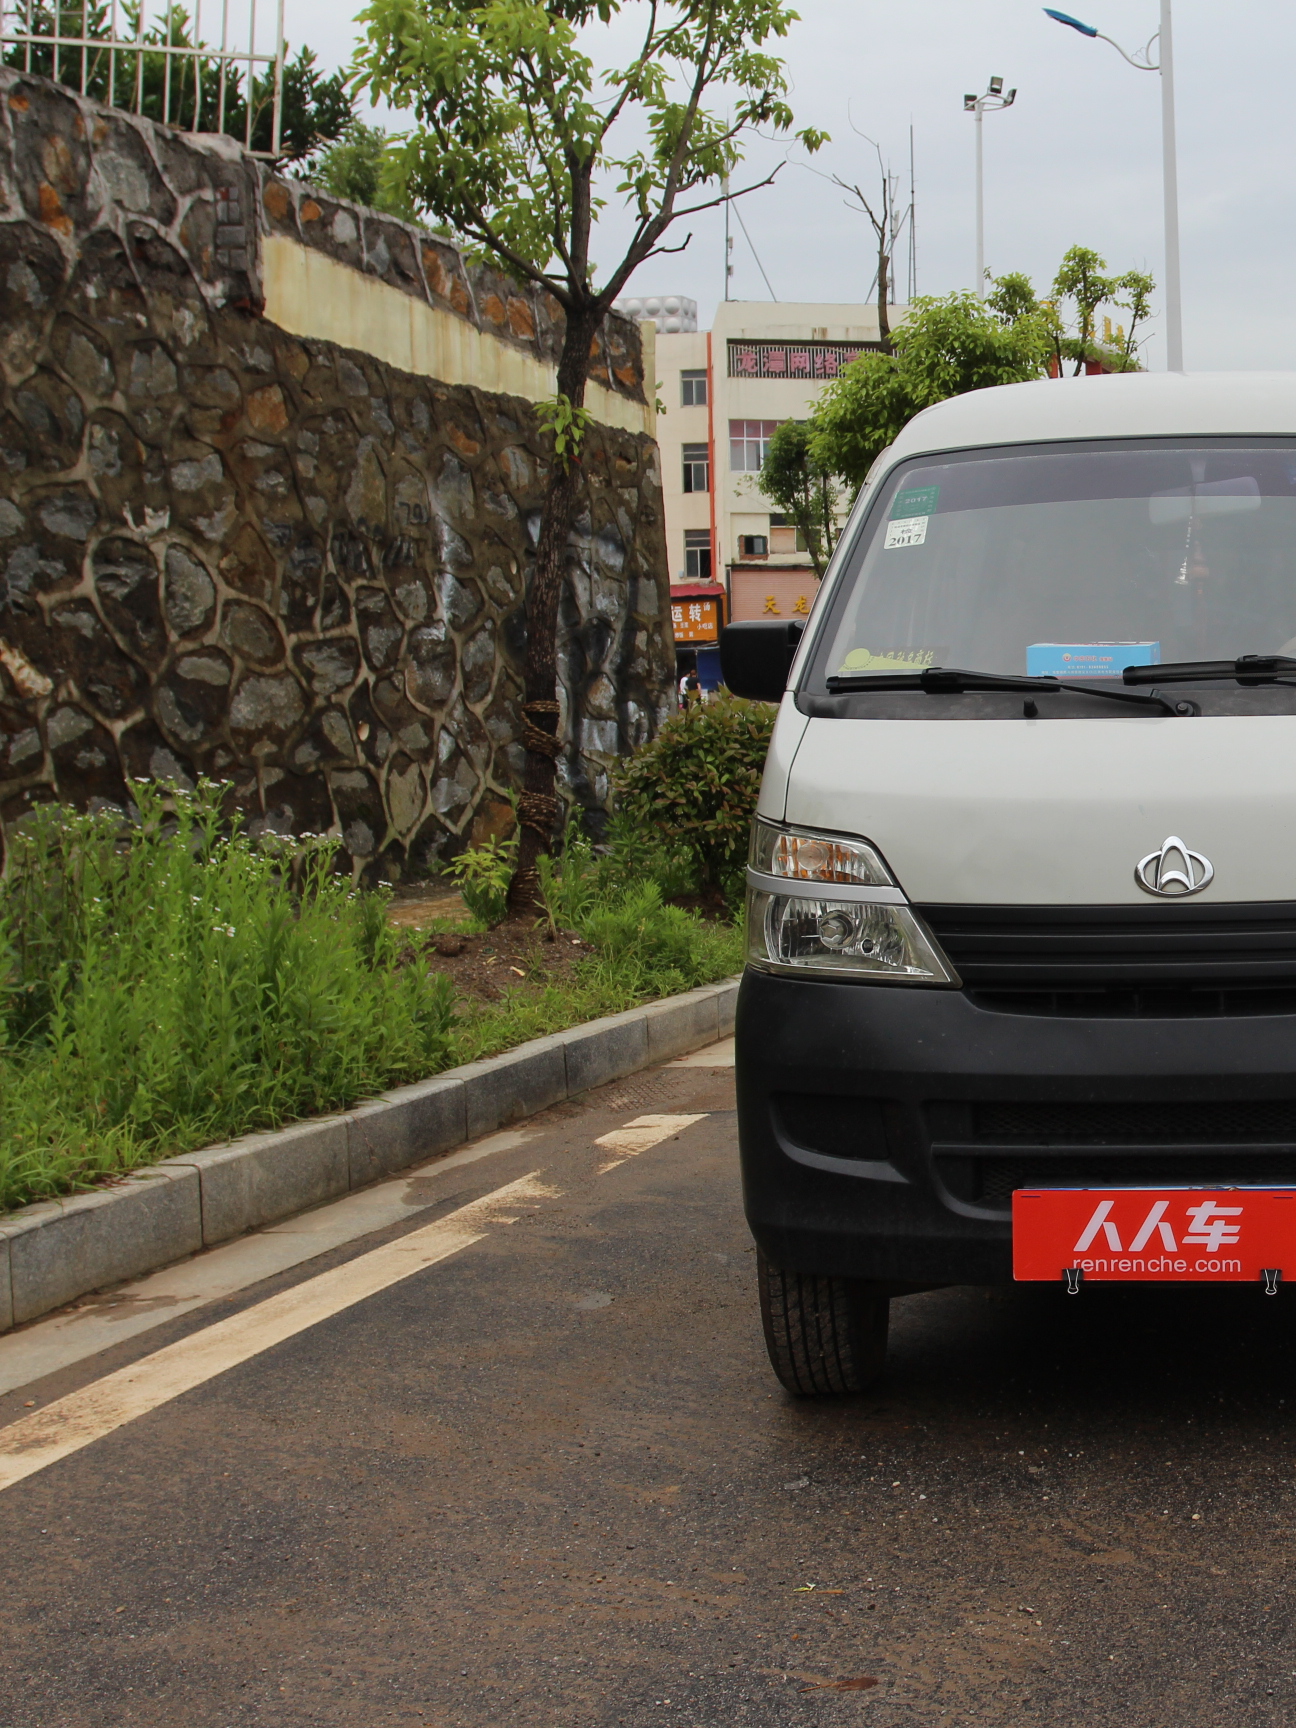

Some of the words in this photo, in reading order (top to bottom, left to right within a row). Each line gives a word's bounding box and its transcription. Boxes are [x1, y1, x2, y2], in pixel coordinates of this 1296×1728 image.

[904, 495, 928, 504] 2017
[889, 533, 922, 546] 2017
[1073, 1200, 1244, 1252] 人人车
[1073, 1255, 1242, 1273] renrenche.com
